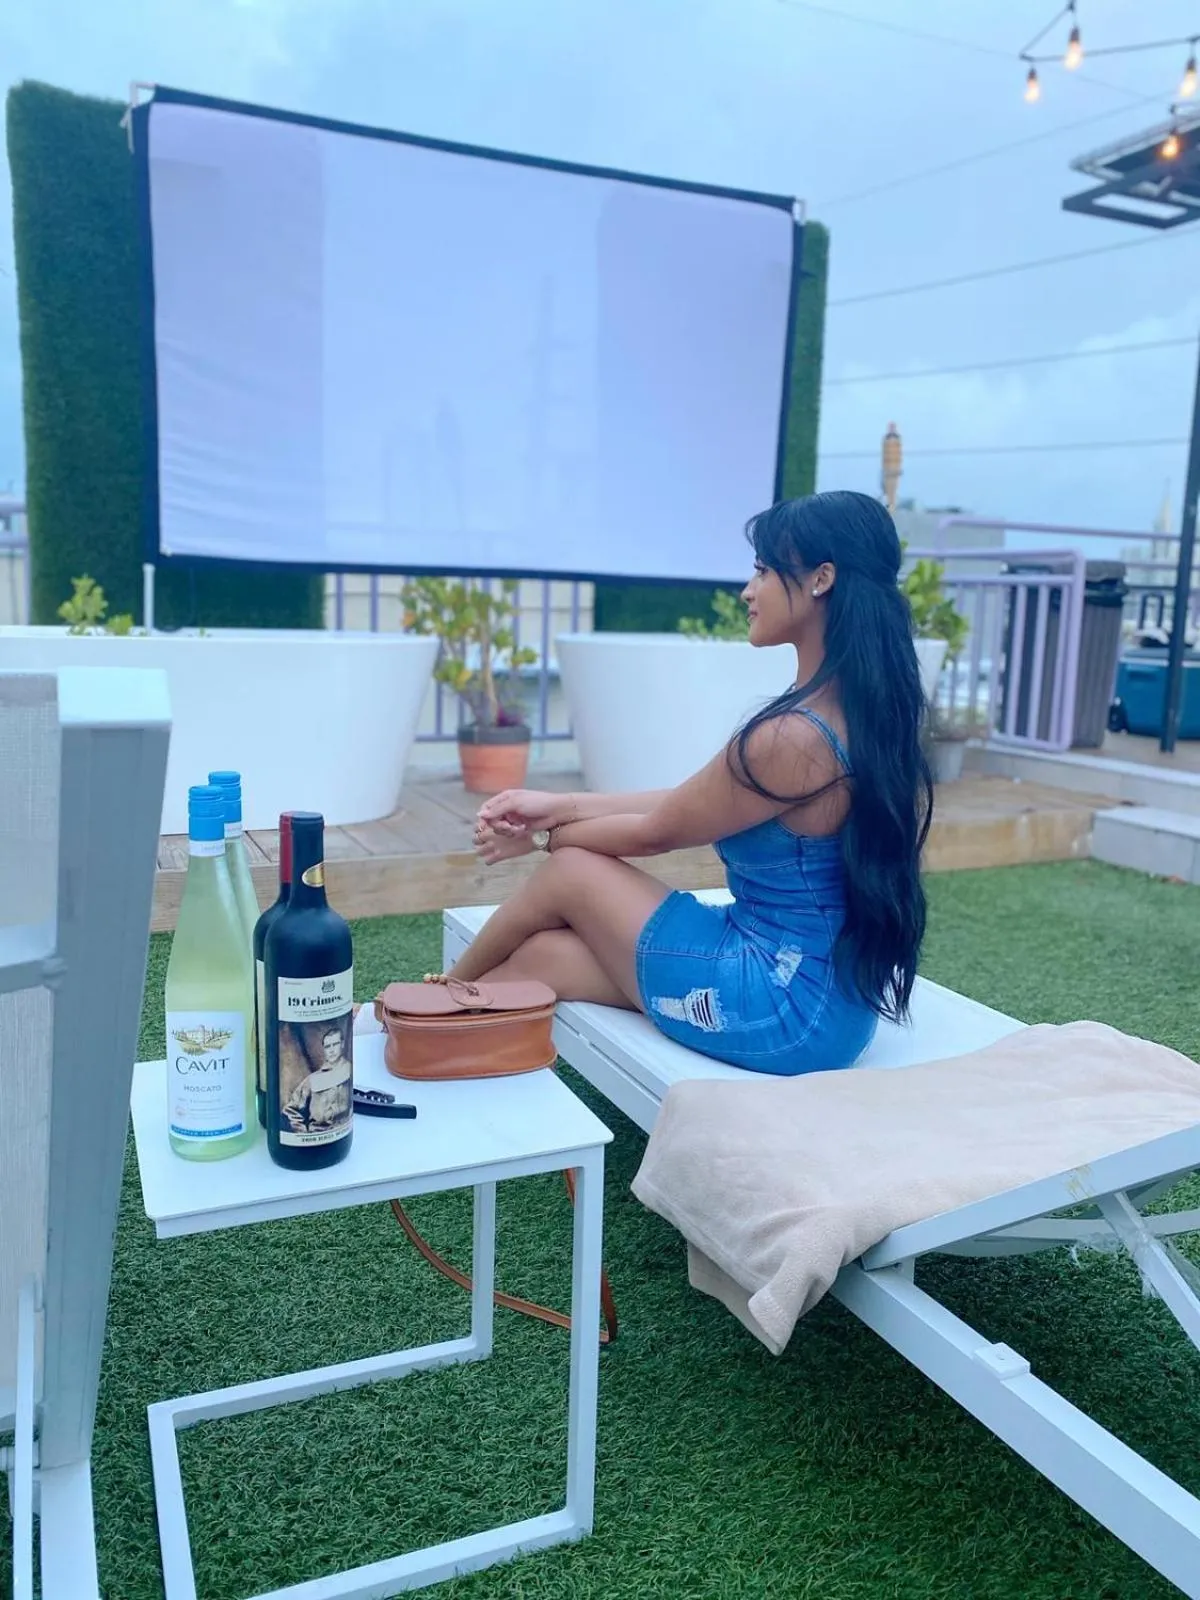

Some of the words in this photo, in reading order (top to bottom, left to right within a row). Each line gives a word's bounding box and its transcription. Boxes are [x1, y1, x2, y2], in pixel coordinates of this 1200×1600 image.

[288, 996, 300, 1006] 19
[175, 1056, 230, 1075] CAVIT
[184, 1085, 222, 1093] MOSCATO
